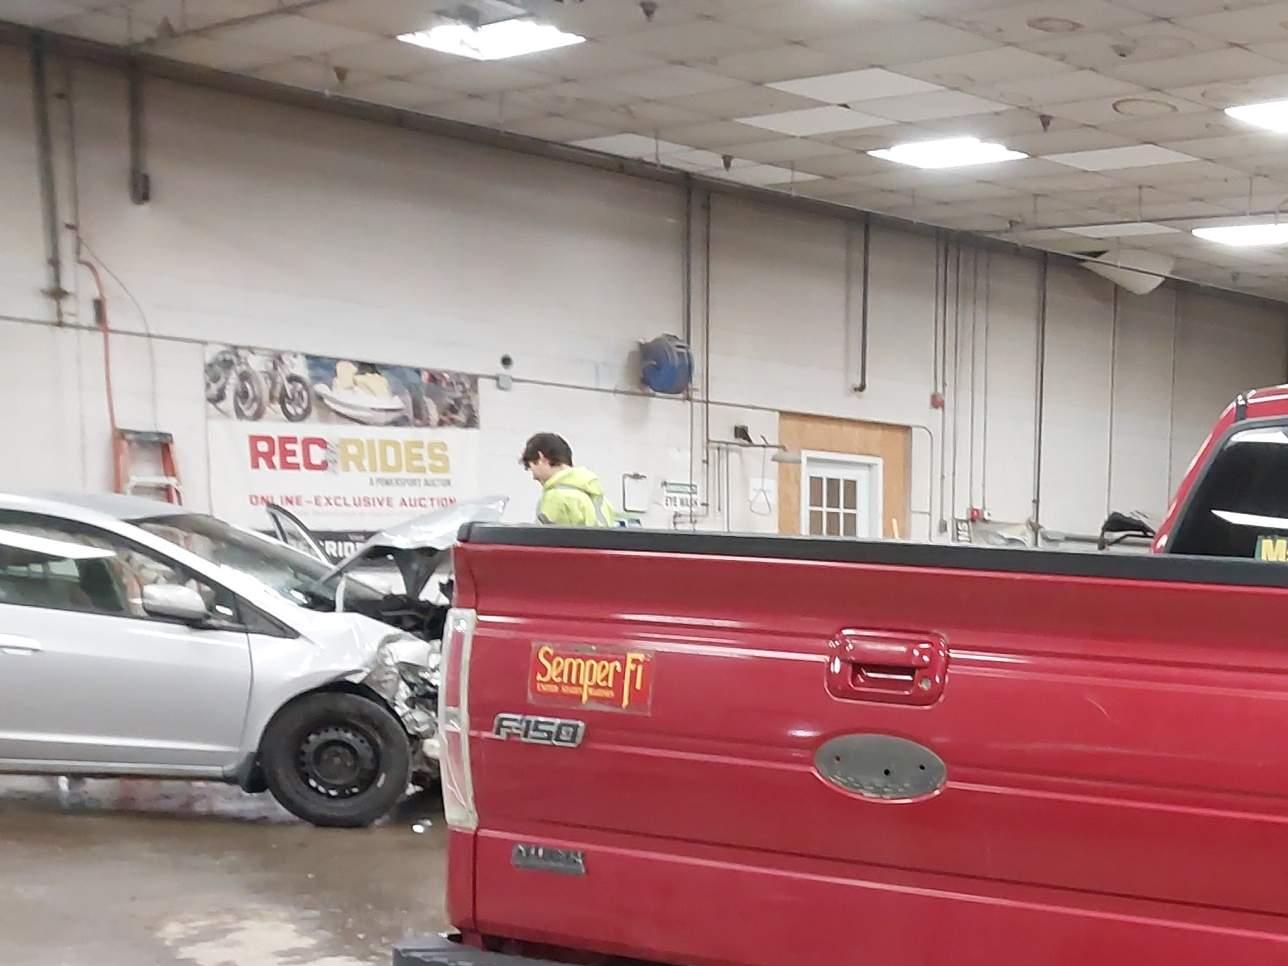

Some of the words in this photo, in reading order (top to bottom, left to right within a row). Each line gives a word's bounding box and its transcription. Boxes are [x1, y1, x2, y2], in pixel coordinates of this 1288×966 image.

[248, 435, 329, 471] REC
[339, 437, 451, 474] RIDES
[536, 646, 621, 704] Semper
[621, 652, 645, 709] Fi
